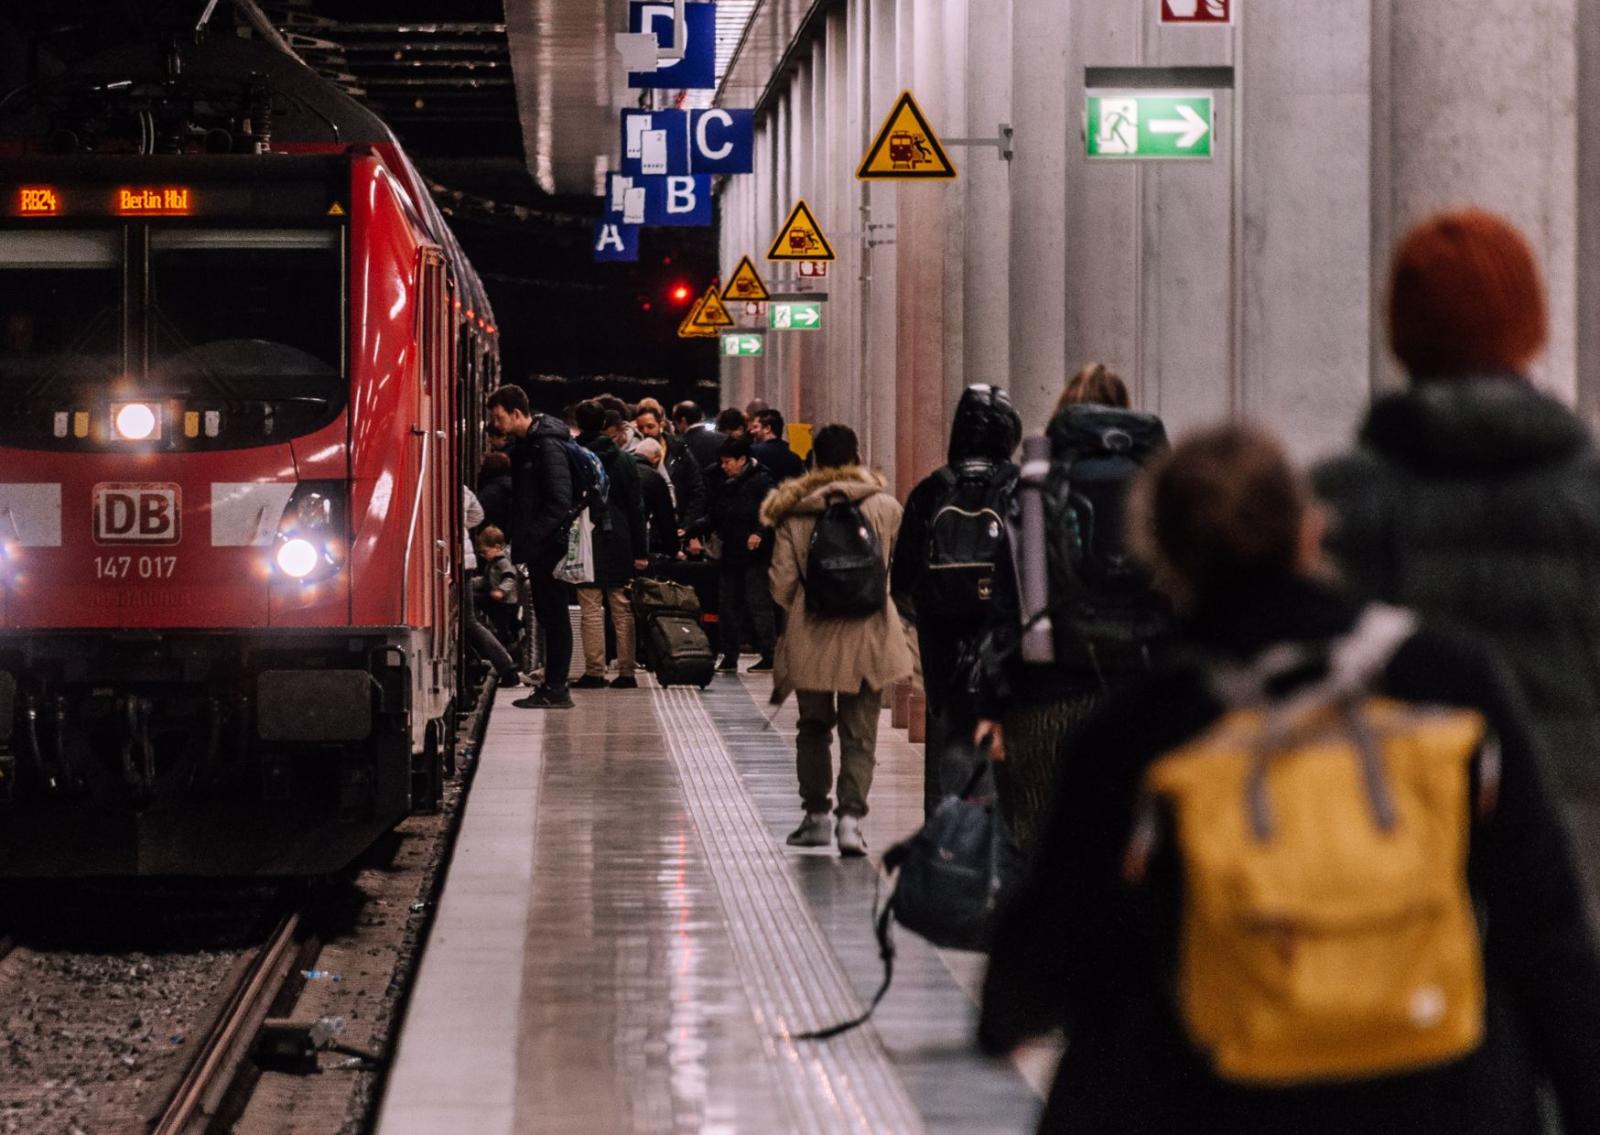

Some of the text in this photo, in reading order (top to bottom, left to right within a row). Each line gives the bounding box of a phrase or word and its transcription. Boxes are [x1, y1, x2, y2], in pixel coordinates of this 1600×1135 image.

[641, 5, 688, 68] D
[656, 132, 664, 143] 2
[696, 109, 734, 160] C
[21, 189, 56, 210] RB24
[120, 189, 162, 209] Berlin
[667, 176, 697, 215] B
[596, 223, 625, 252] A
[105, 493, 171, 535] DB
[94, 555, 177, 579] 147 017
